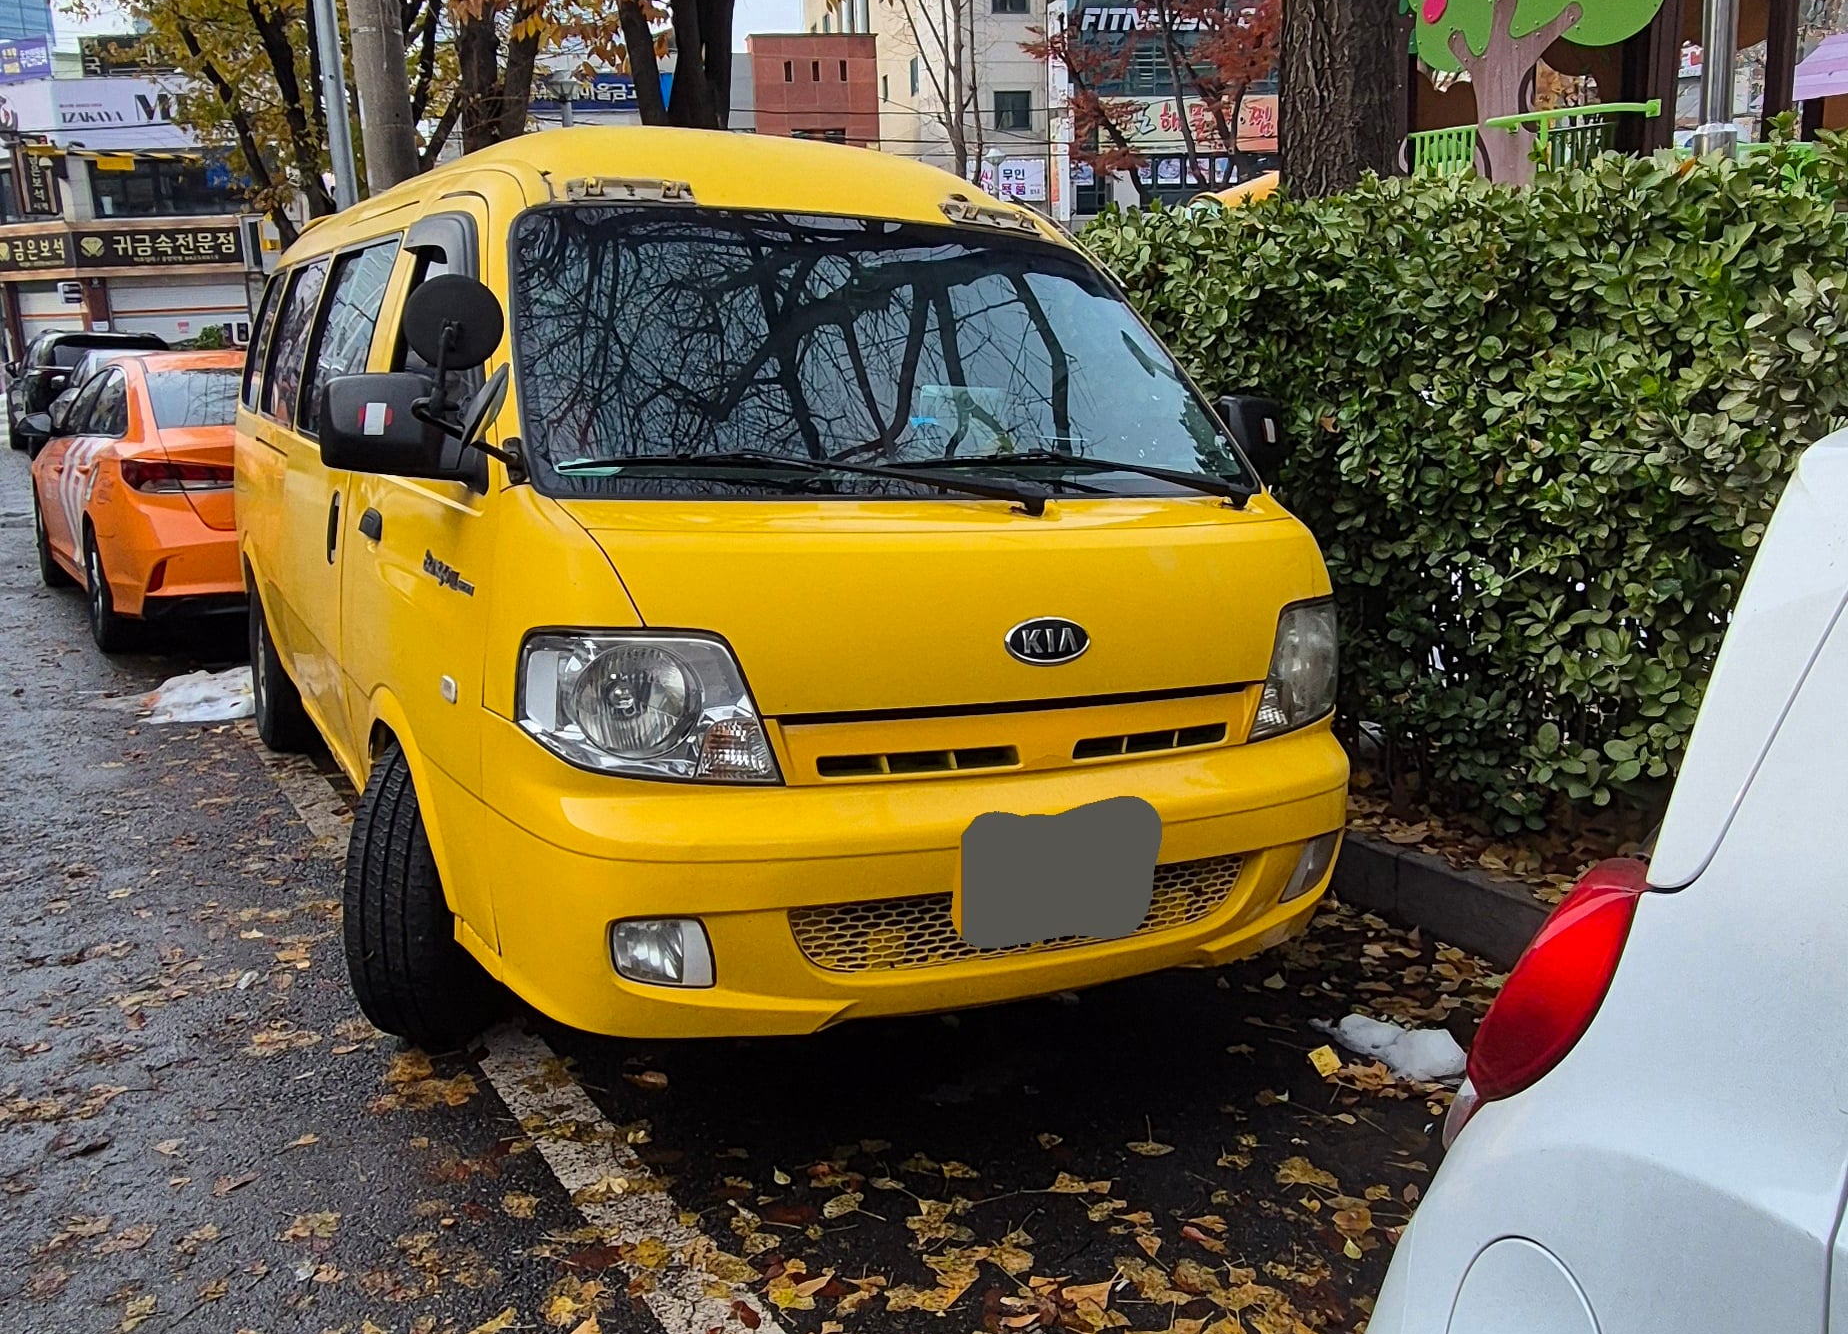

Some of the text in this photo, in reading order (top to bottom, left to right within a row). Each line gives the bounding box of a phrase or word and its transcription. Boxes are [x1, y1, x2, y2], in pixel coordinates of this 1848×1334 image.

[61, 111, 124, 124] IZAKAYA
[1002, 168, 1025, 181] 무인
[12, 237, 65, 261] 금은보석
[112, 232, 236, 256] 귀금속전문점
[1021, 627, 1079, 654] KIA
